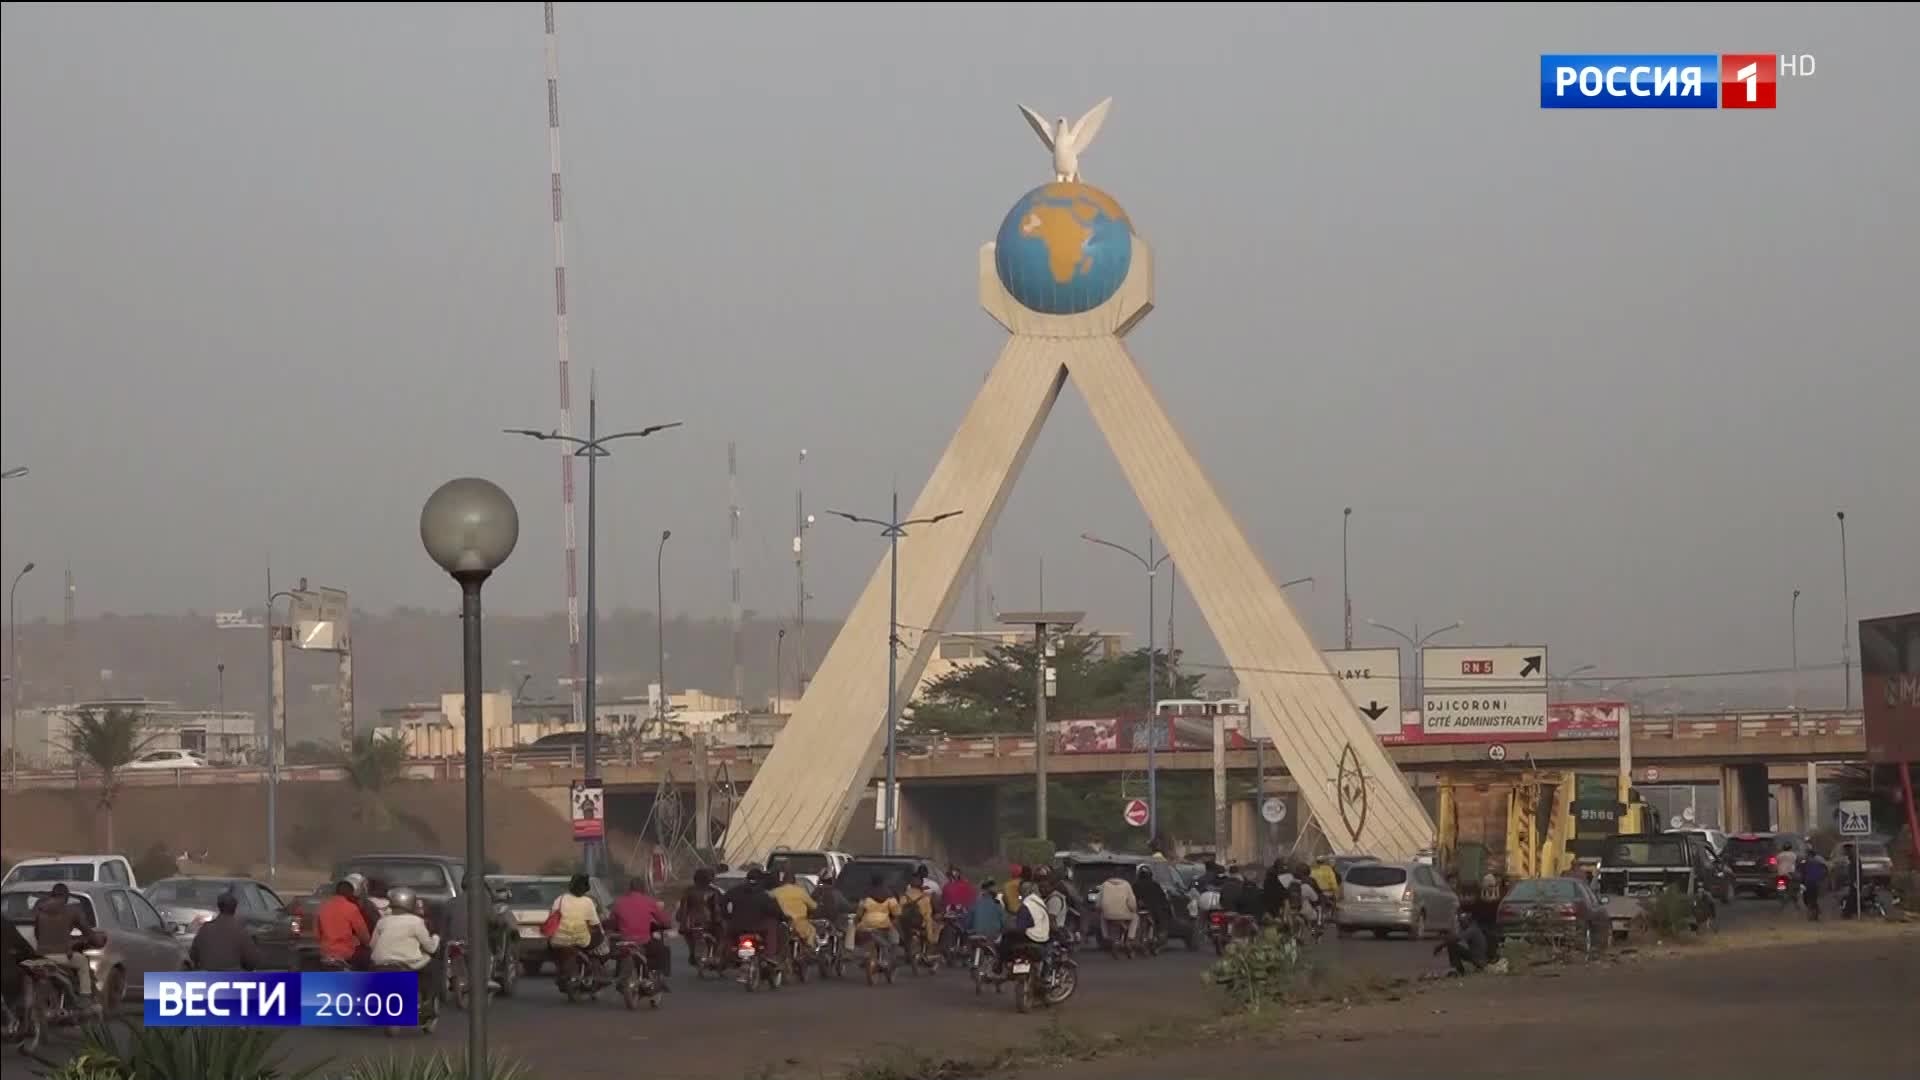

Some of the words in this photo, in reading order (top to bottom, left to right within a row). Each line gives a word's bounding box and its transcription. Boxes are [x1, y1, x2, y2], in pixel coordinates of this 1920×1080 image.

[1337, 669, 1370, 680] LAYE
[1427, 700, 1507, 711] DJICORONI
[1454, 715, 1544, 727] ADMINISTRATIVE
